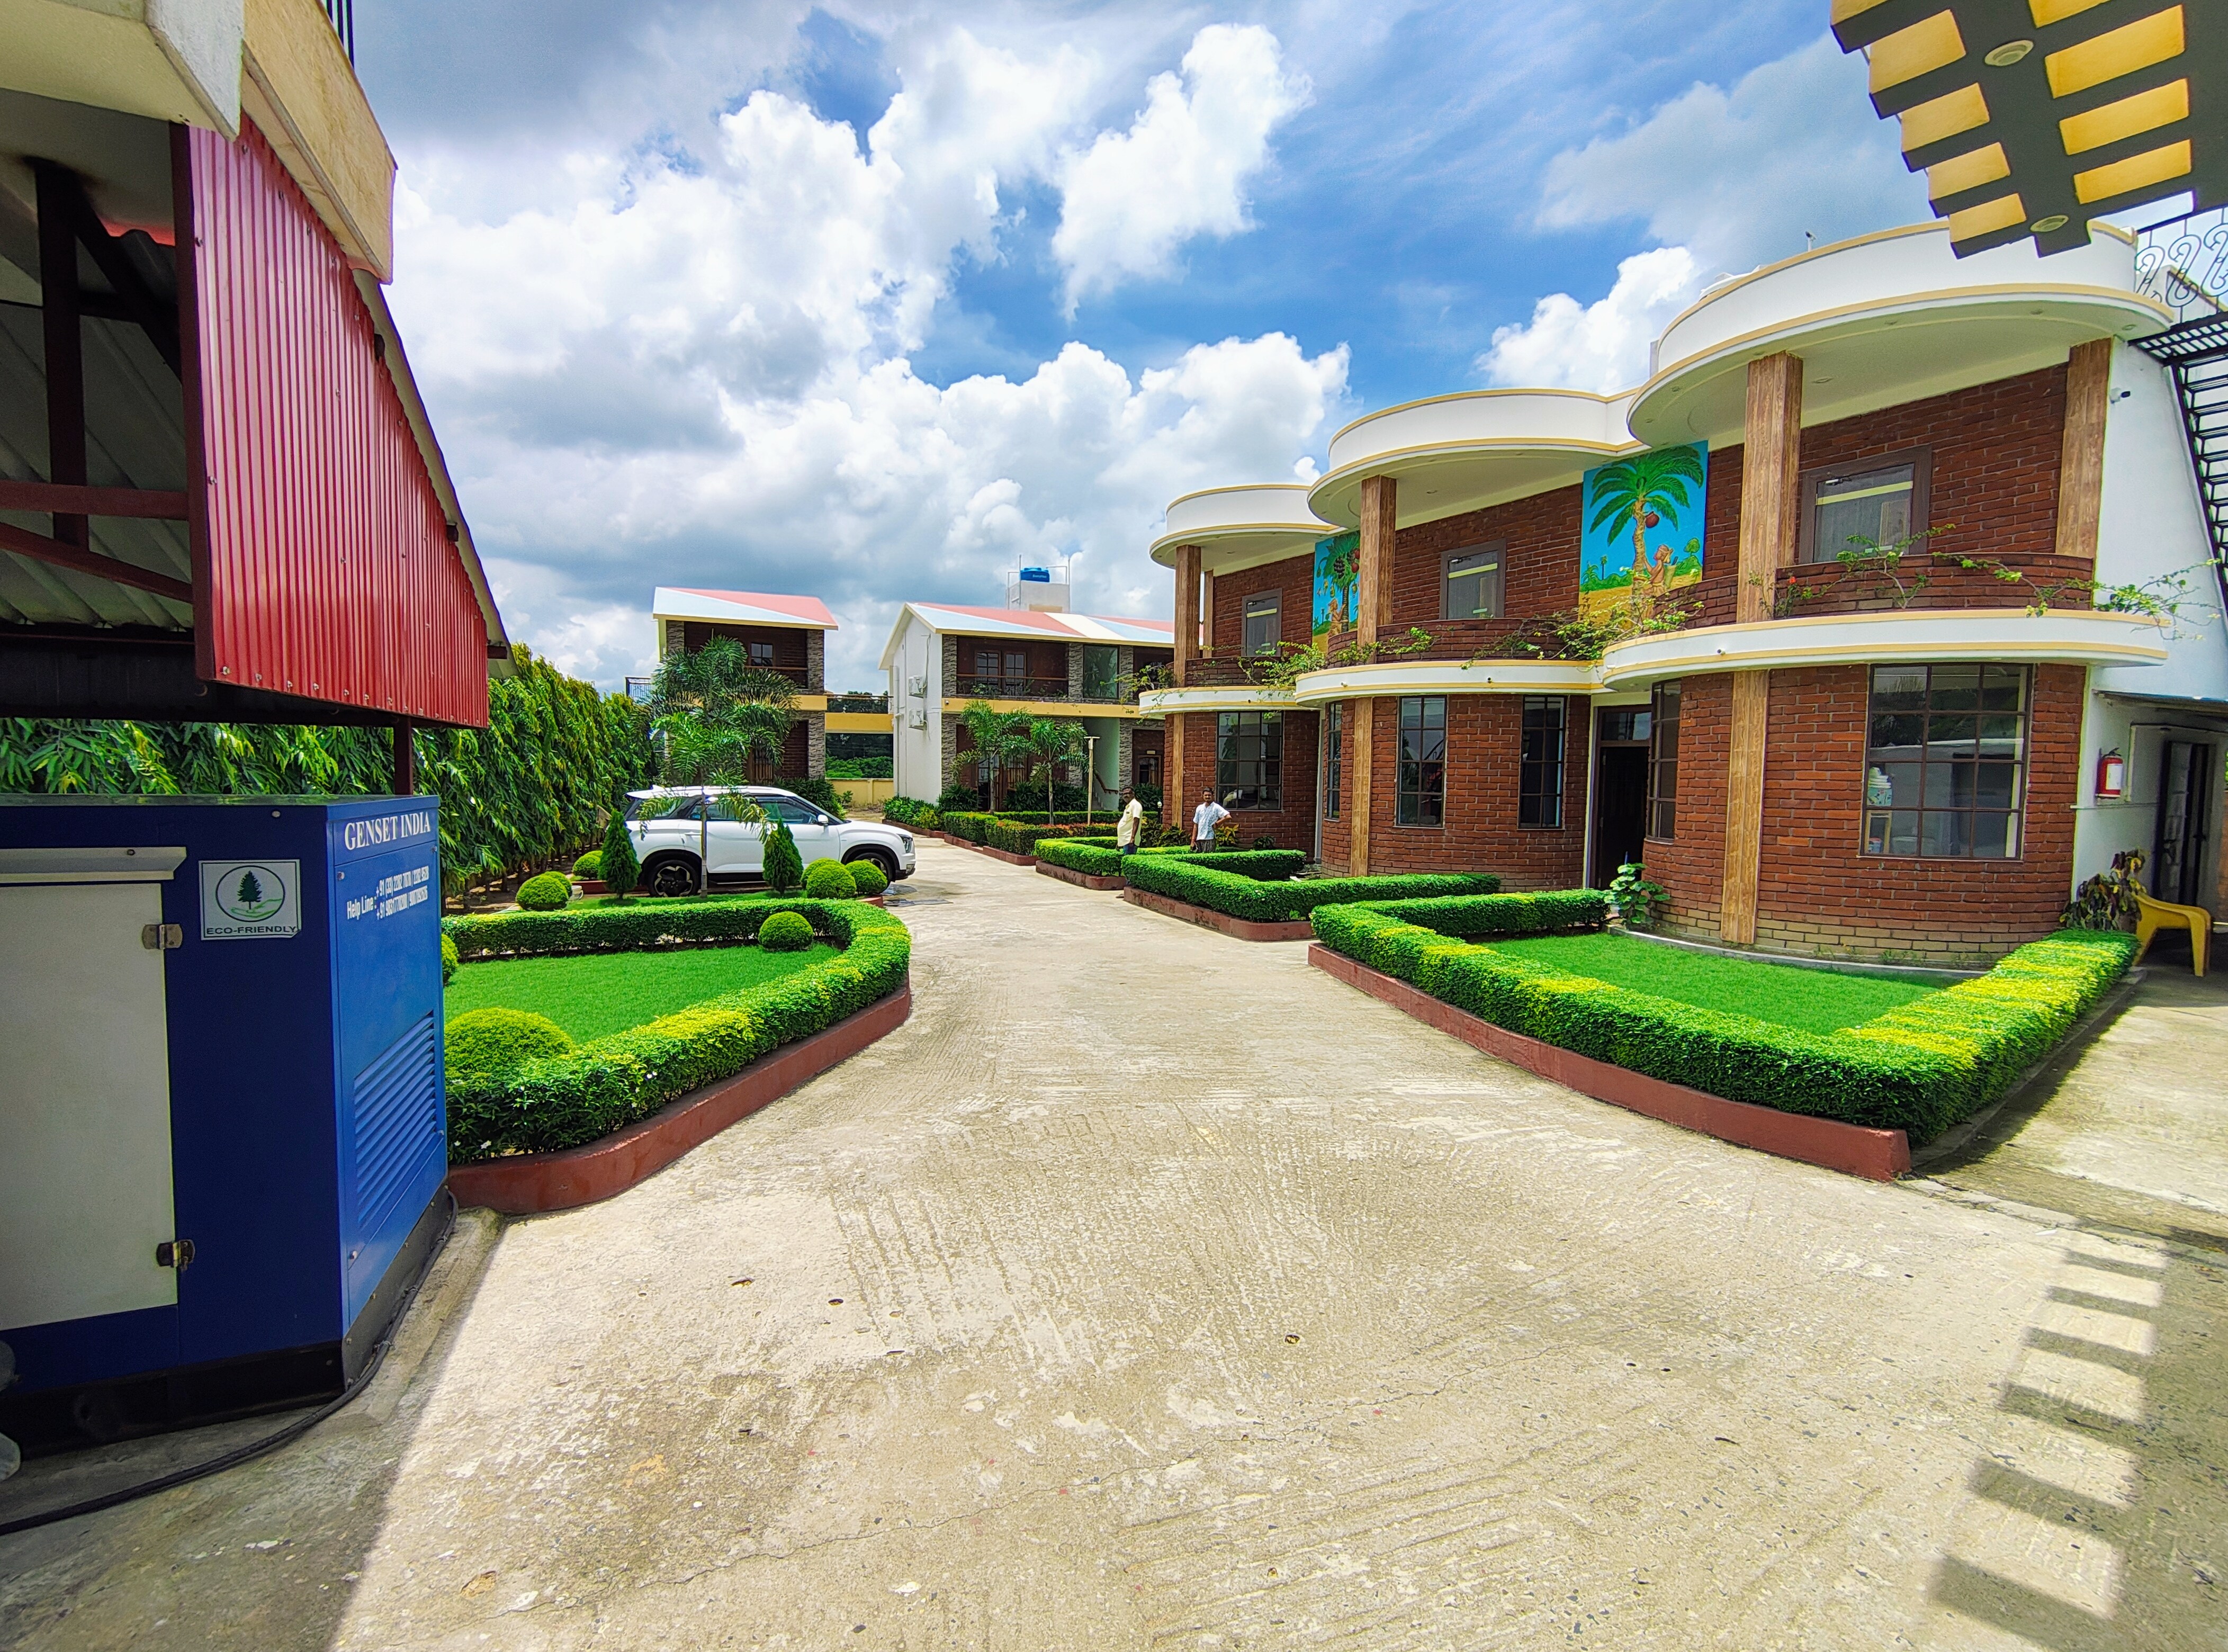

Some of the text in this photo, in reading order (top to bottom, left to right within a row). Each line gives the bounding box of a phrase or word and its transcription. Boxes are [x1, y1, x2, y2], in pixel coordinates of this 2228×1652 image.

[345, 812, 431, 850] GENSET INDIA
[347, 899, 361, 920] Help
[361, 895, 374, 914] Line
[206, 926, 297, 935] ECO-FRIENDLY
